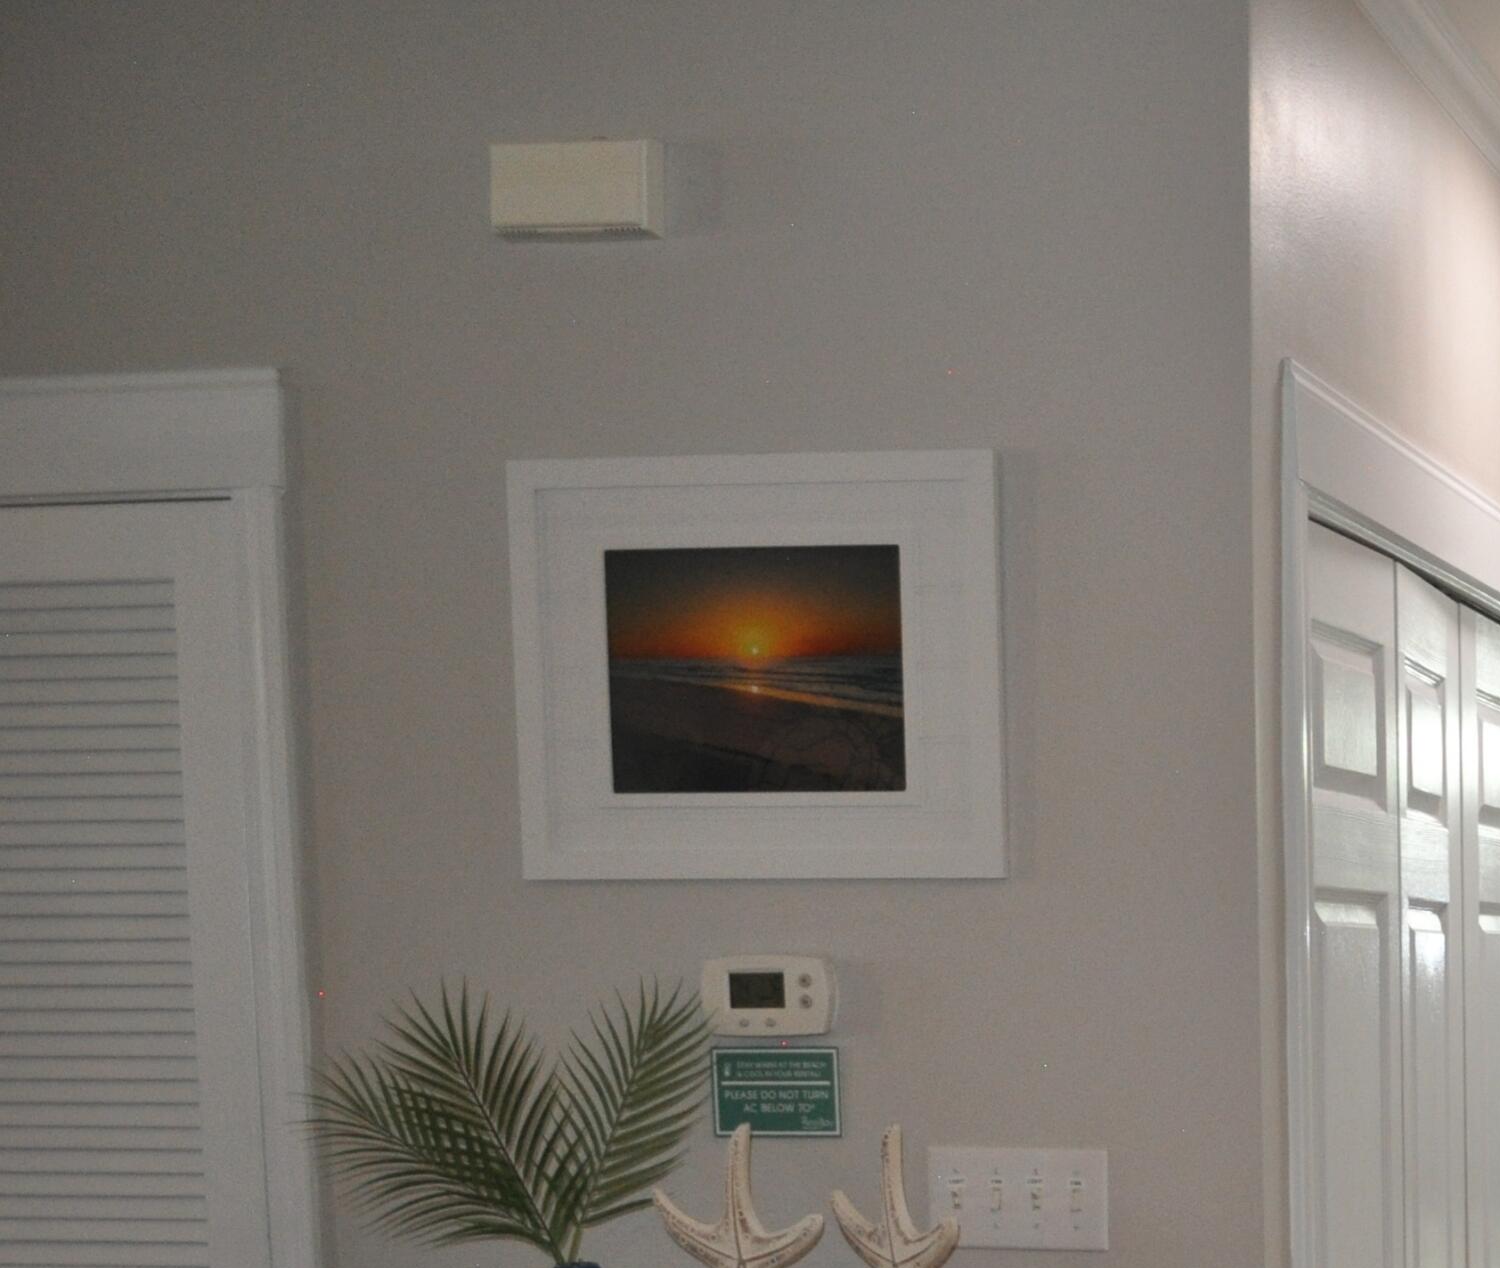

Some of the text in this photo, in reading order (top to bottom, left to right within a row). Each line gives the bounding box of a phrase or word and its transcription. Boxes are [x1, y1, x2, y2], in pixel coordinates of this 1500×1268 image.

[724, 1090, 829, 1100] PLEASE DO NOT TURN
[743, 1103, 758, 1113] AC
[760, 1103, 795, 1113] BELOW
